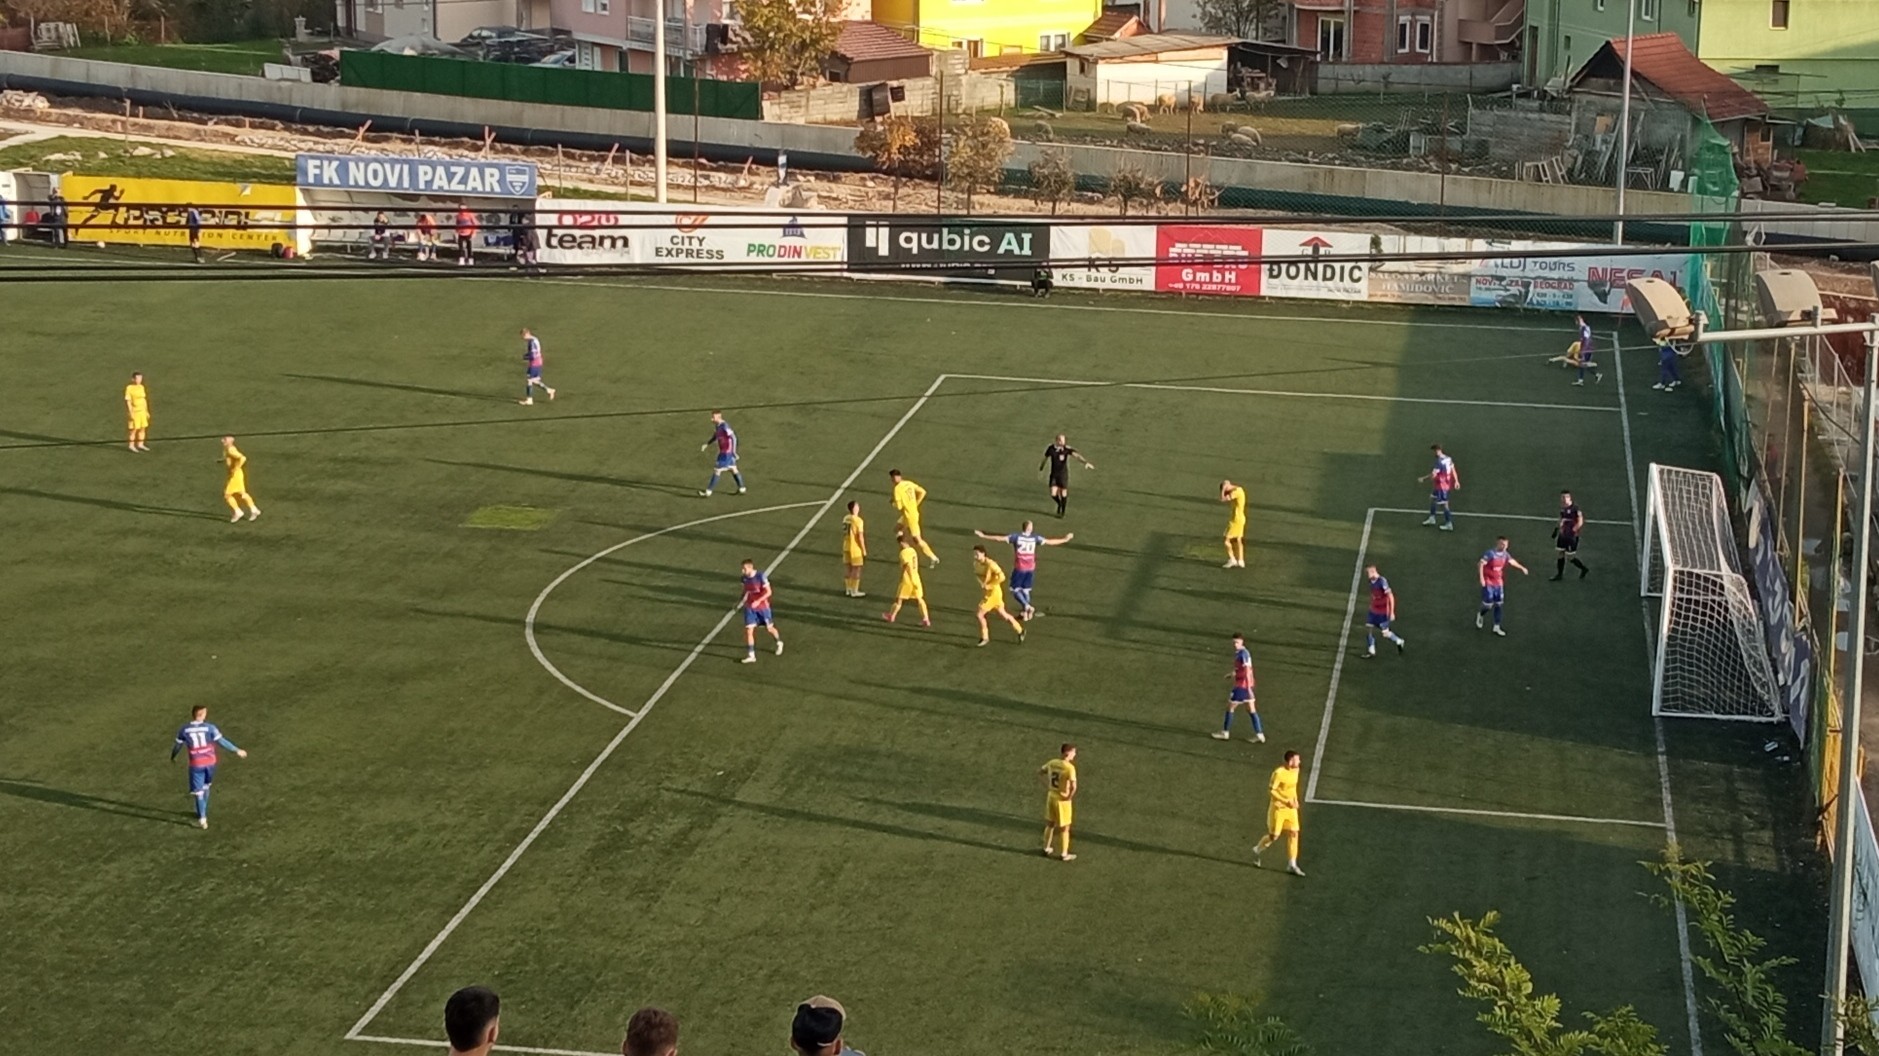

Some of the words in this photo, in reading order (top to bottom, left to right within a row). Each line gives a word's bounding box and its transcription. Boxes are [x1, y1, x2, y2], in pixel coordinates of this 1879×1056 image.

[307, 159, 340, 185] FK
[349, 162, 410, 188] NOVI
[418, 166, 501, 192] PAZAR
[231, 233, 278, 242] CENTER
[545, 228, 630, 250] team
[669, 235, 706, 247] CITY
[898, 227, 991, 254] qubic
[997, 232, 1033, 256] AI
[655, 247, 725, 260] EXPRESS
[747, 243, 841, 260] PRODINVEST
[1086, 274, 1106, 283] Bau
[1109, 276, 1143, 285] GmbH
[1181, 268, 1236, 283] GmbH
[1017, 541, 1036, 555] 20
[189, 732, 208, 749] 11
